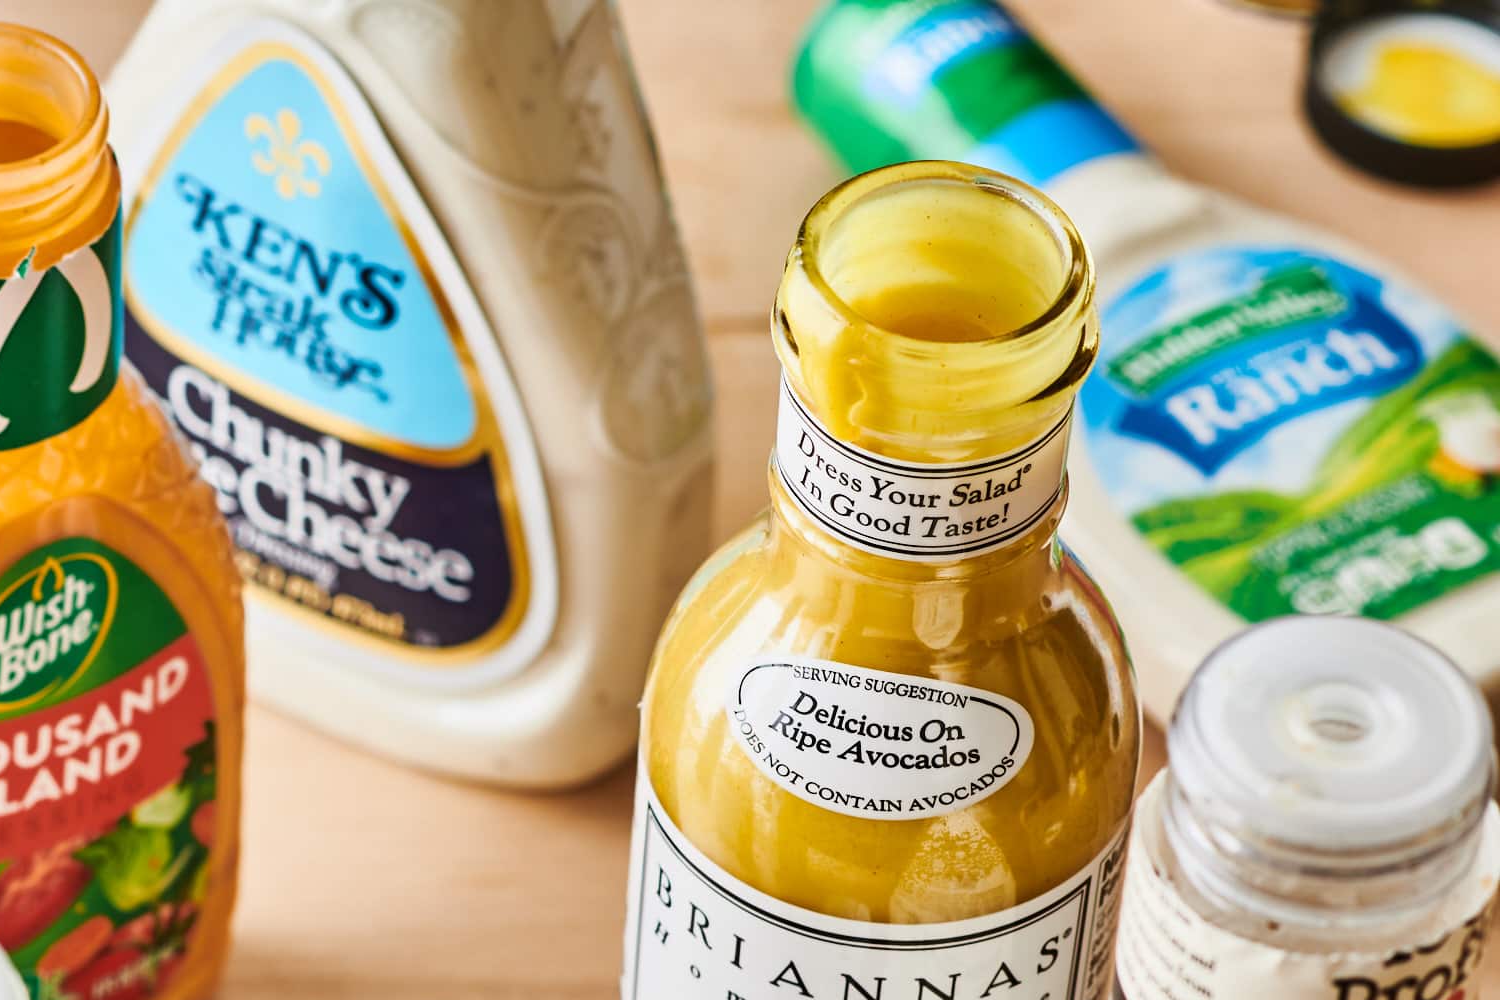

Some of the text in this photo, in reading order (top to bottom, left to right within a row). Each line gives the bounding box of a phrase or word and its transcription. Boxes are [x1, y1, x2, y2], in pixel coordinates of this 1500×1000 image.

[1164, 328, 1400, 446] Ranch
[168, 365, 411, 531] Chunky
[797, 430, 862, 493] Dress
[869, 476, 941, 508] Your
[799, 467, 1010, 538] In Good Taste!
[789, 690, 965, 743] Delicious On
[792, 665, 970, 709] SERVING SUGGESTION
[733, 709, 1015, 813] DOES NOT CONTAIN AVOCADOS
[768, 710, 981, 771] Ripe Avocados
